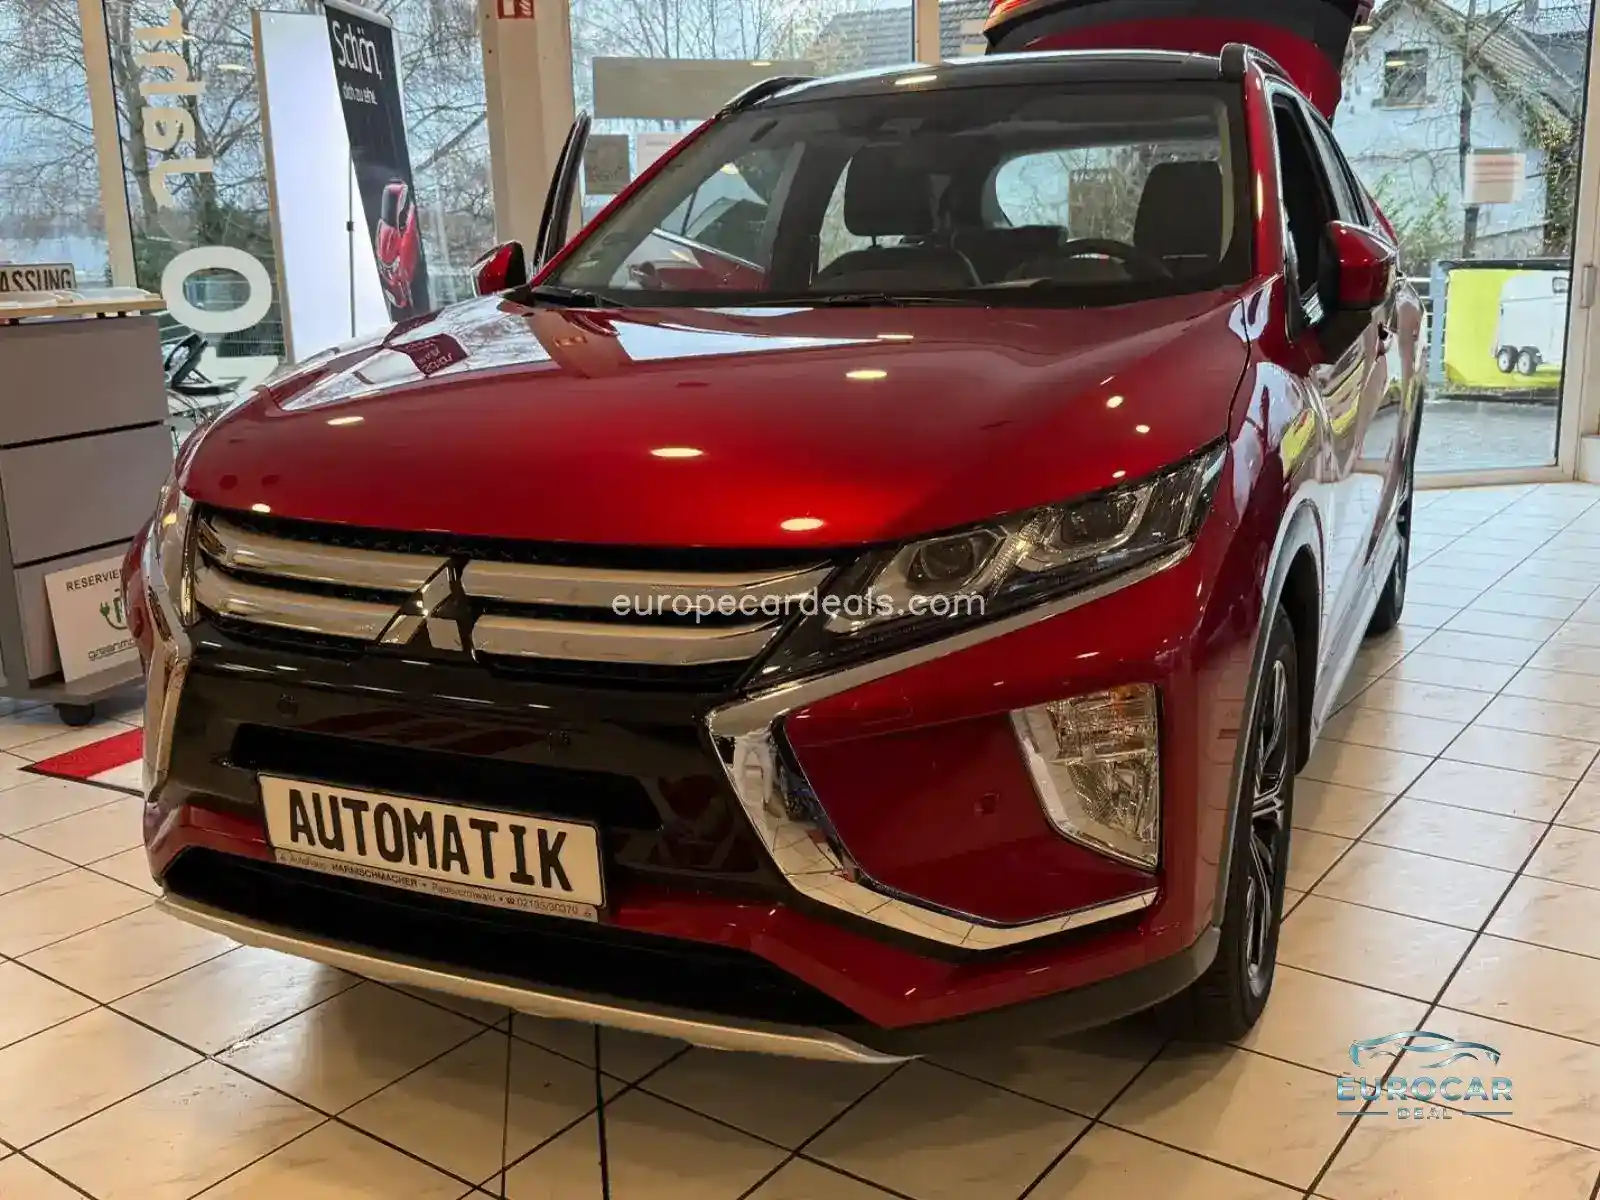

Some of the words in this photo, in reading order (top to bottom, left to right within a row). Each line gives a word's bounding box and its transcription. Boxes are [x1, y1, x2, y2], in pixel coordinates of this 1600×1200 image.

[332, 20, 383, 80] Schön,
[65, 568, 122, 592] RESERVIE
[288, 787, 574, 892] AUTOMATIK
